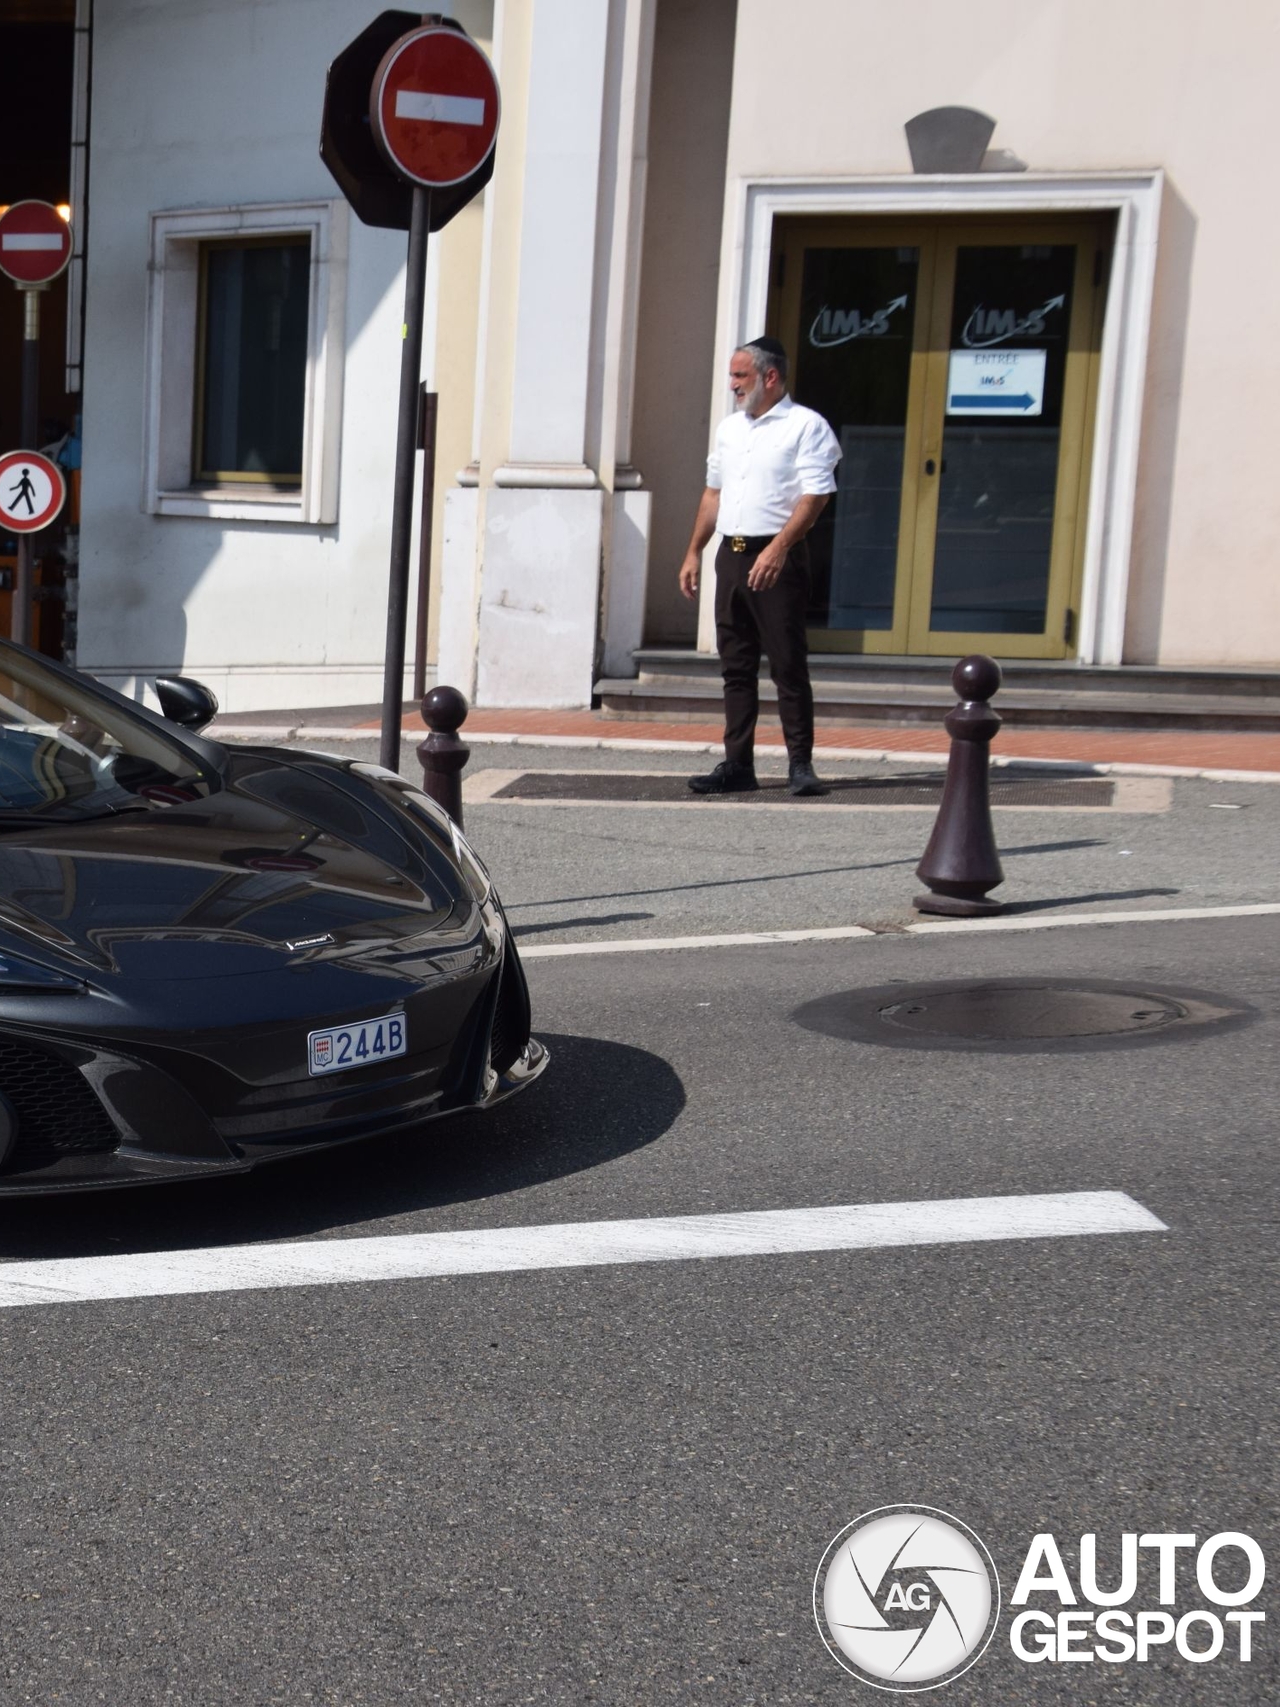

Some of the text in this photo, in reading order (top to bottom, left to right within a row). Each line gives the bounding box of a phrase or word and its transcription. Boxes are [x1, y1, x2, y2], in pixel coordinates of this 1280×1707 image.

[974, 350, 1020, 365] ENTRÉE
[337, 1021, 403, 1065] 244B
[317, 1052, 329, 1062] MC
